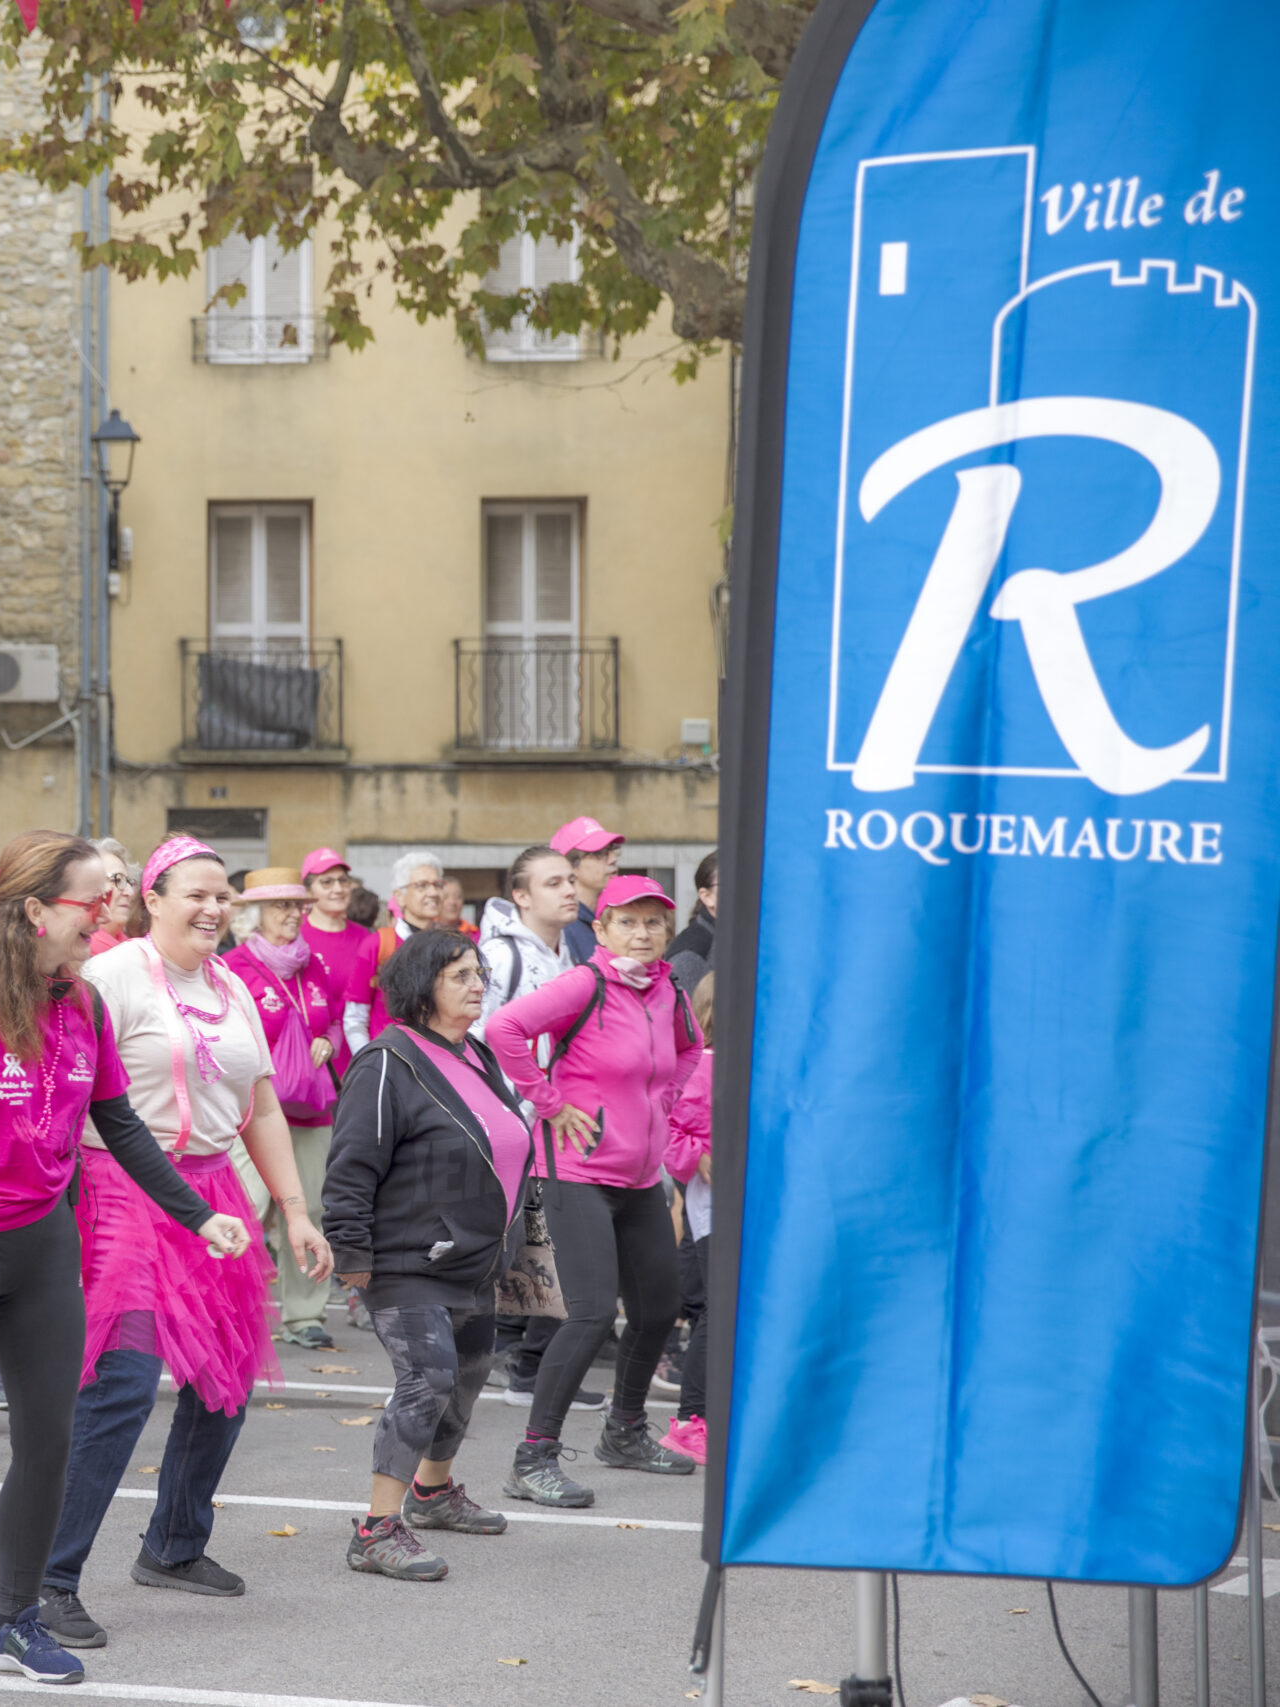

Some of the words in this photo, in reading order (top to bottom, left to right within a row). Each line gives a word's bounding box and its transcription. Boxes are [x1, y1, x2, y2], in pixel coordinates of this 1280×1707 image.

[1040, 176, 1165, 236] Ville
[1184, 168, 1247, 225] de
[823, 808, 1224, 866] ROQUEMAURE
